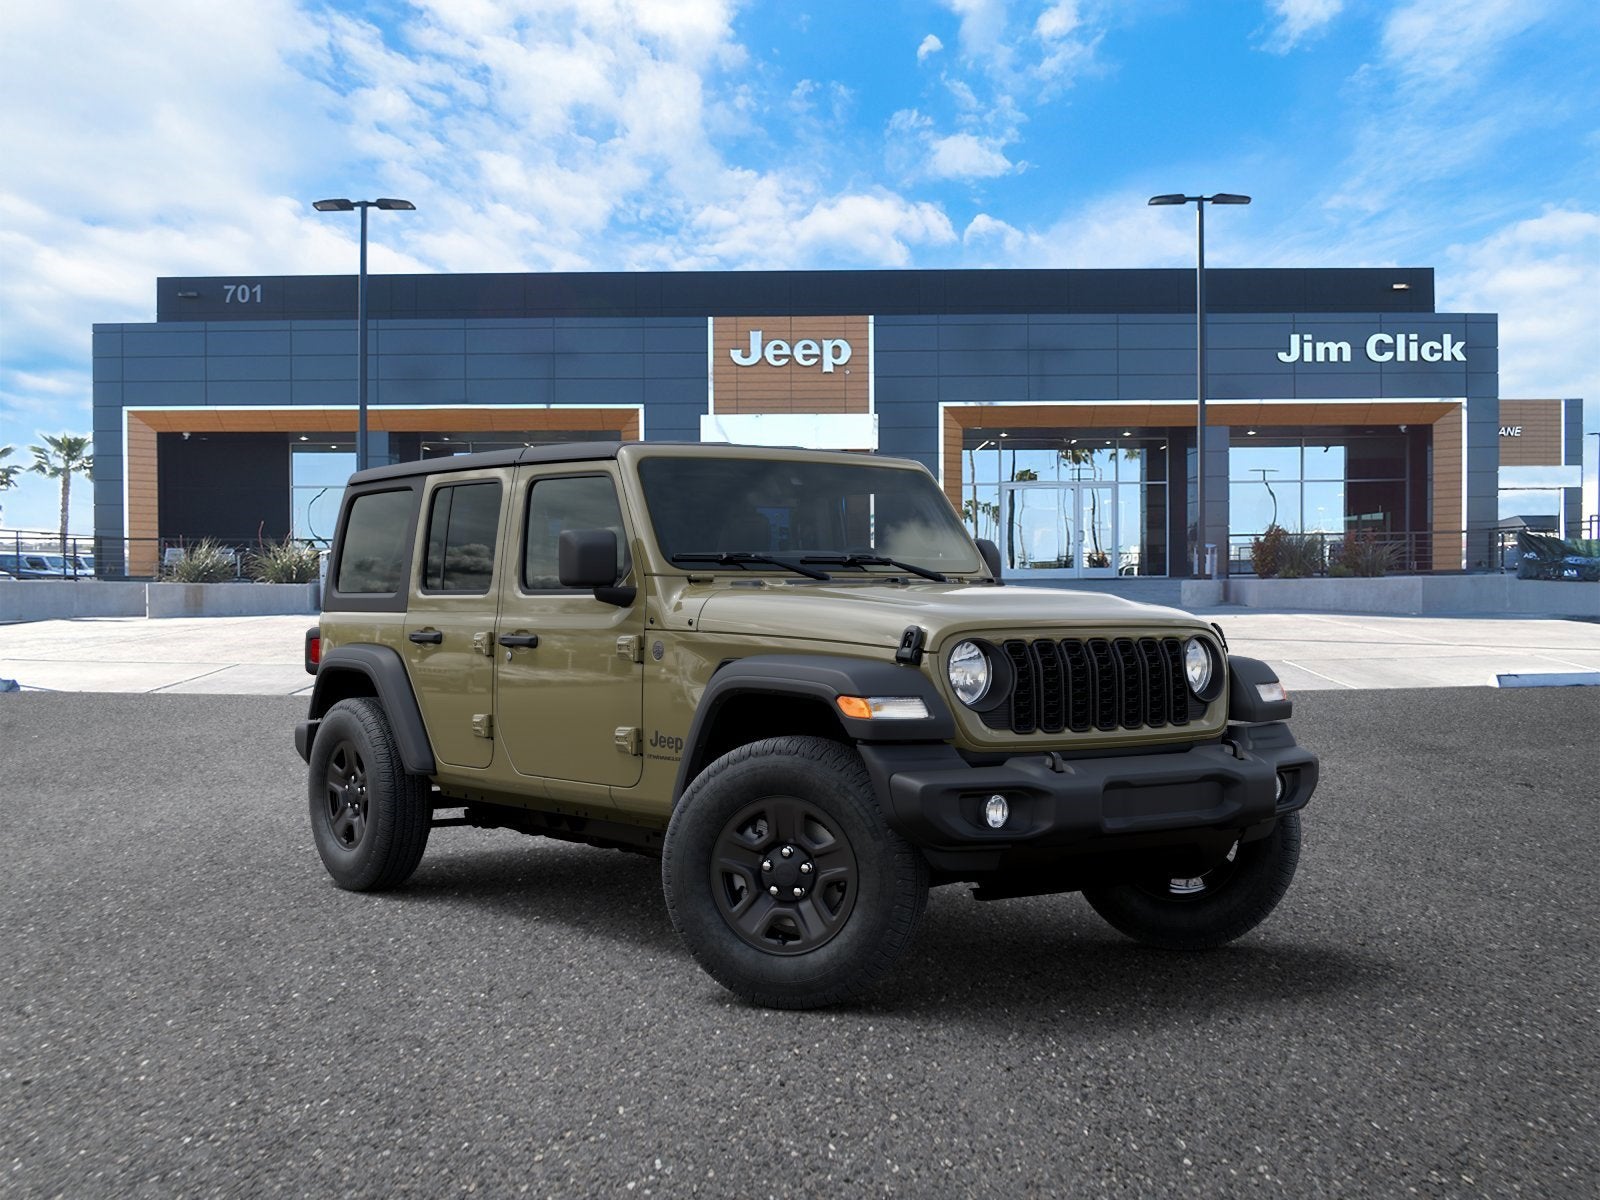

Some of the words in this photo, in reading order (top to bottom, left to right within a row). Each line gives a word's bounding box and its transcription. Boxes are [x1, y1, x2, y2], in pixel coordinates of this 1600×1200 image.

[223, 284, 262, 304] 701
[730, 330, 852, 373] Jeep
[1277, 334, 1351, 363] Jim
[1366, 333, 1467, 362] Click
[650, 731, 683, 753] Jeep
